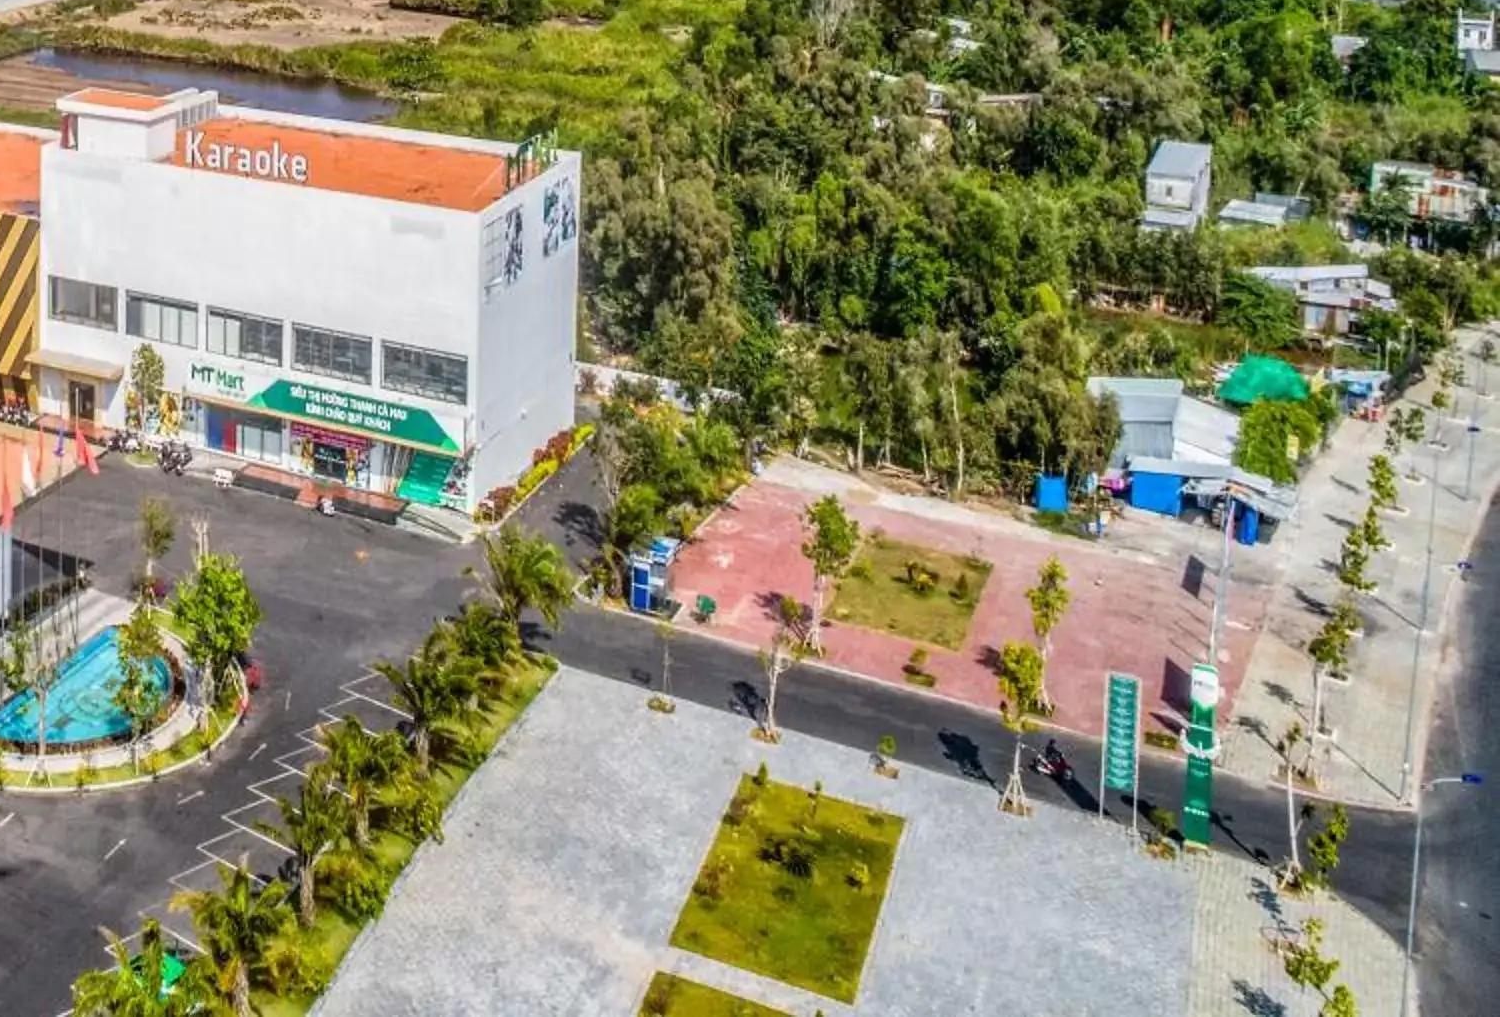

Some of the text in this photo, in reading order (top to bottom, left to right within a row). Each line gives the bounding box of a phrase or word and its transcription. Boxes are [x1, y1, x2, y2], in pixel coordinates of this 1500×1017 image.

[185, 129, 309, 182] Karaoke
[190, 363, 245, 391] MT Mart
